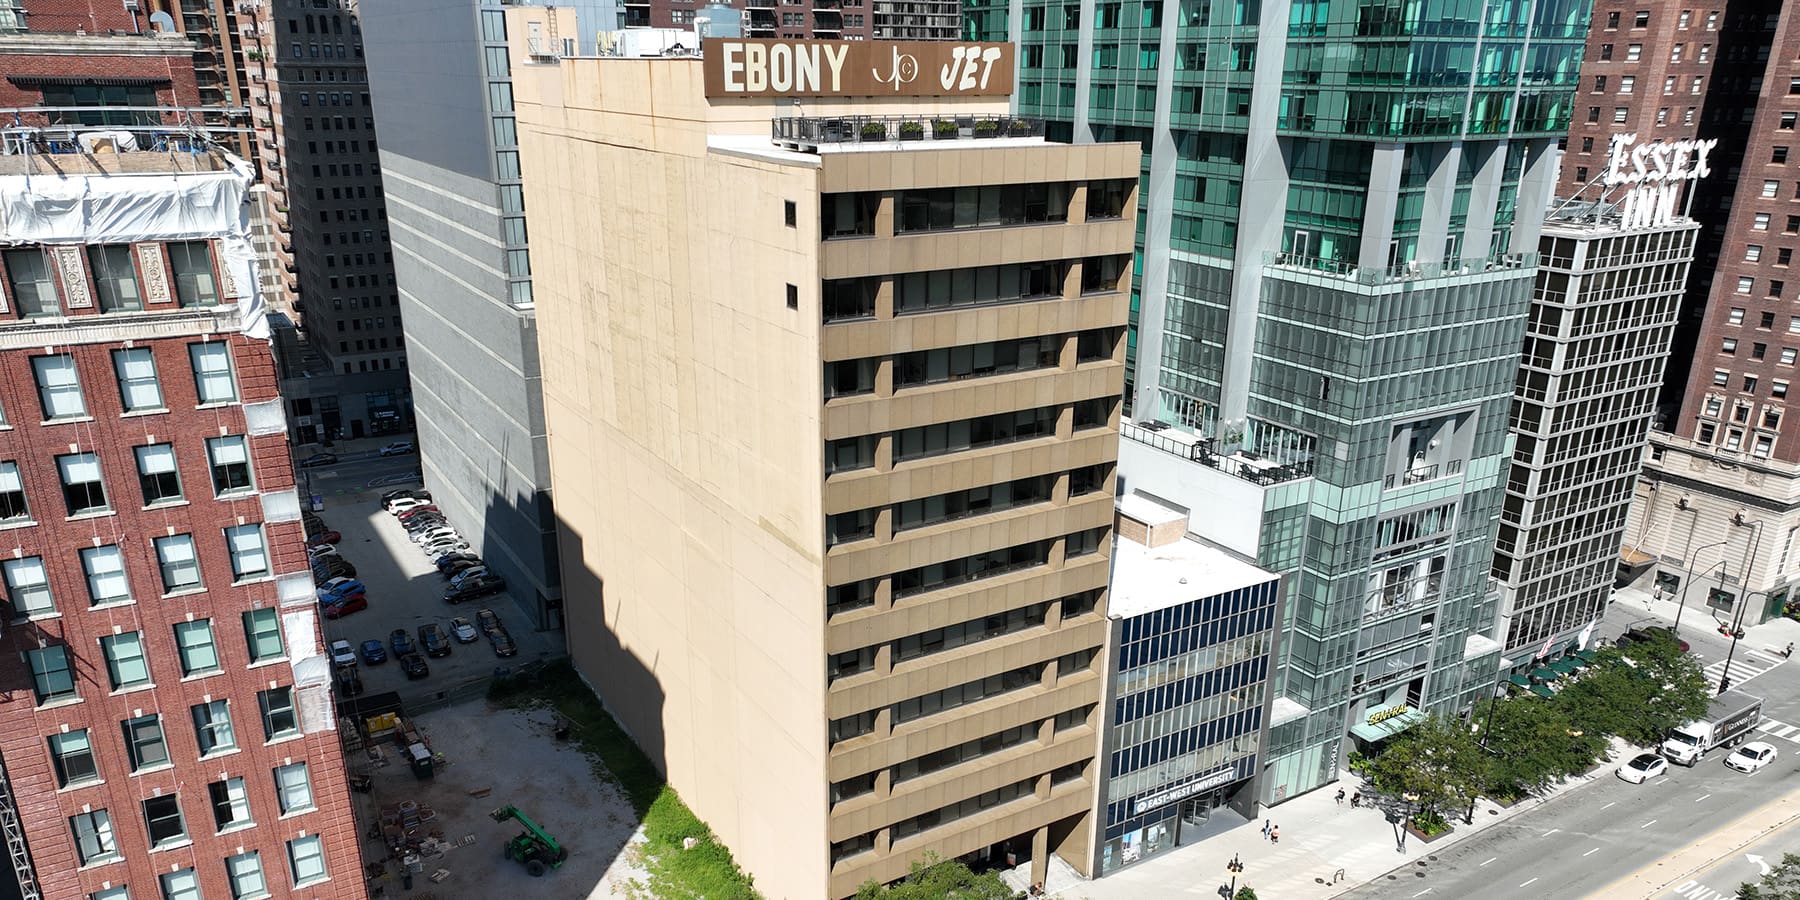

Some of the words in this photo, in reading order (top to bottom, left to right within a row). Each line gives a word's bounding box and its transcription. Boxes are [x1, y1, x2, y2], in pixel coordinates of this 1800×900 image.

[723, 43, 849, 92] EBONY
[940, 46, 1001, 91] JET
[1622, 185, 1679, 231] INN
[1148, 786, 1192, 808] EAST-WEST
[1192, 770, 1234, 793] UNIVERSITY
